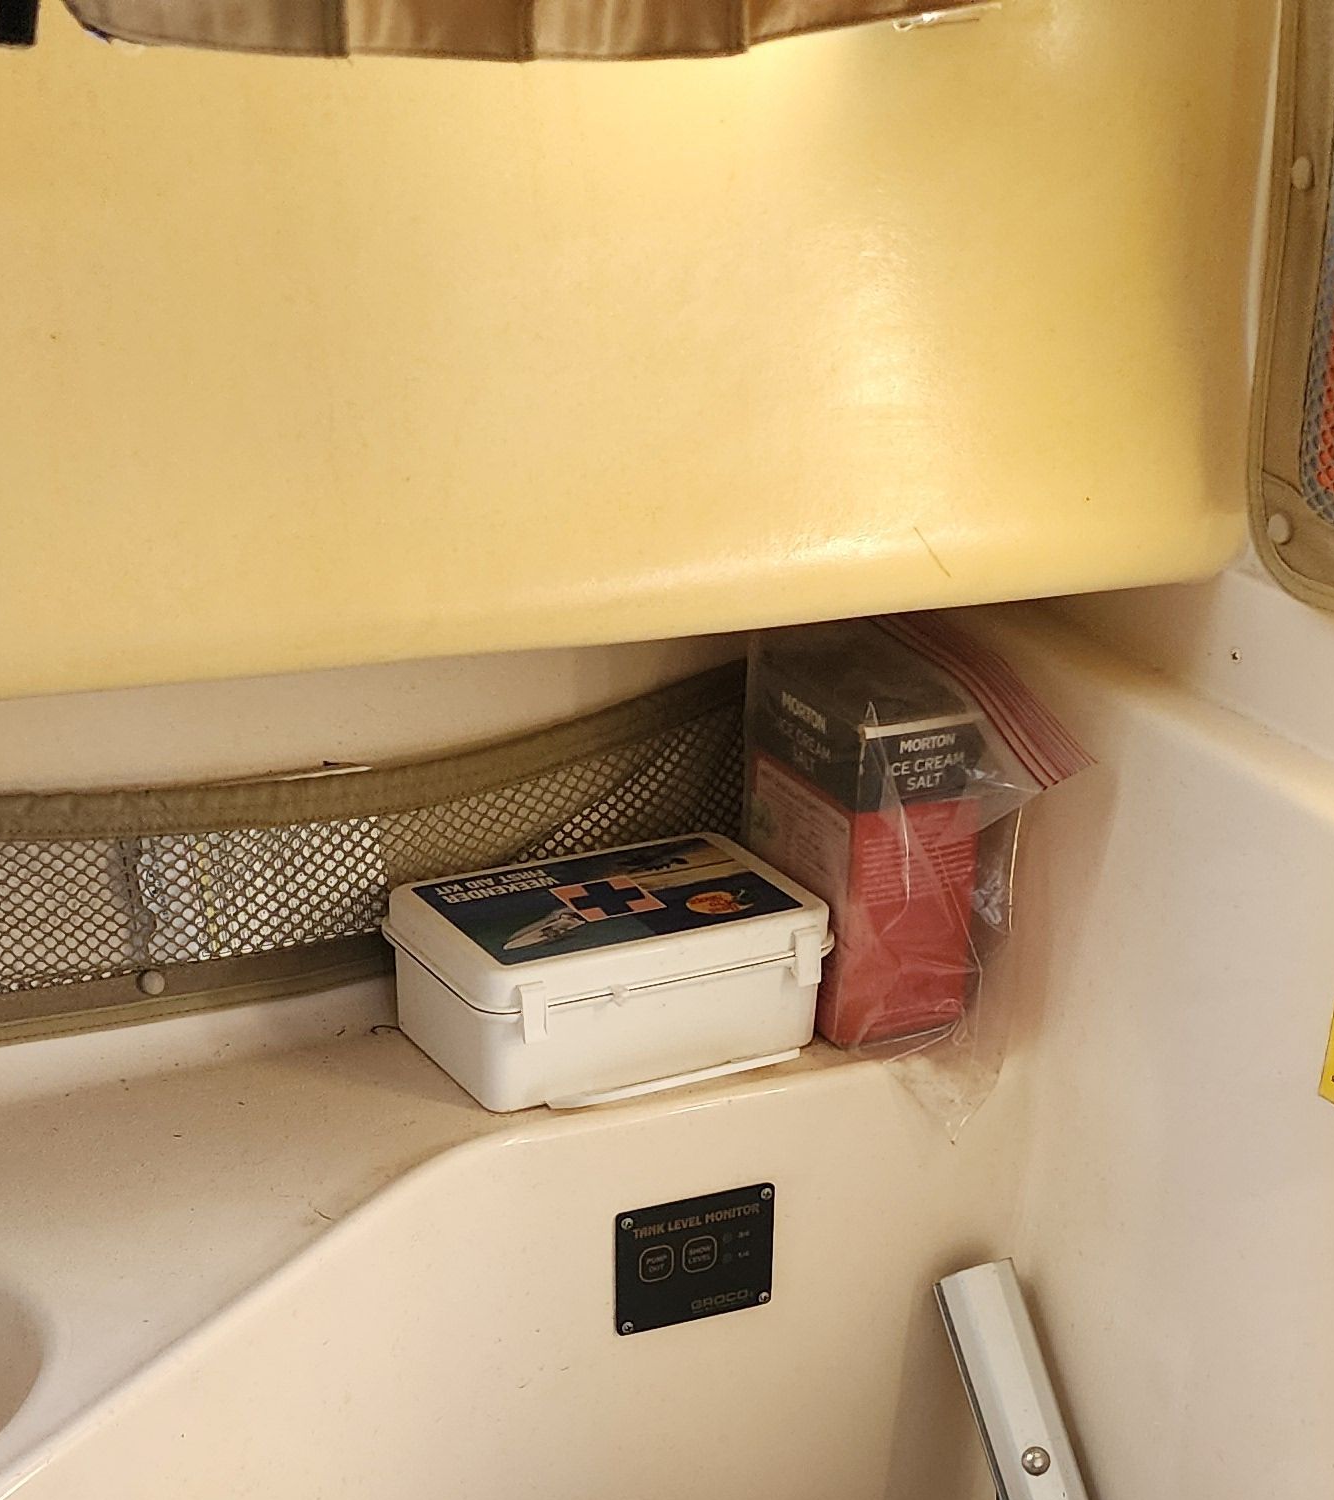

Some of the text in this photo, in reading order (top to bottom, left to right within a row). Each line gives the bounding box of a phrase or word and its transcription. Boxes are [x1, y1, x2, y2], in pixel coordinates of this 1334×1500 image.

[782, 690, 826, 733] MORTON
[899, 732, 955, 754] MORTON
[889, 751, 964, 776] CE CREAM
[906, 772, 943, 792] SALT
[432, 869, 549, 894] FIRST AID KIT
[442, 876, 562, 903] WEEKENDER
[633, 1202, 759, 1239] TANK LEVEL MONITOR
[687, 1253, 710, 1264] LEVEL
